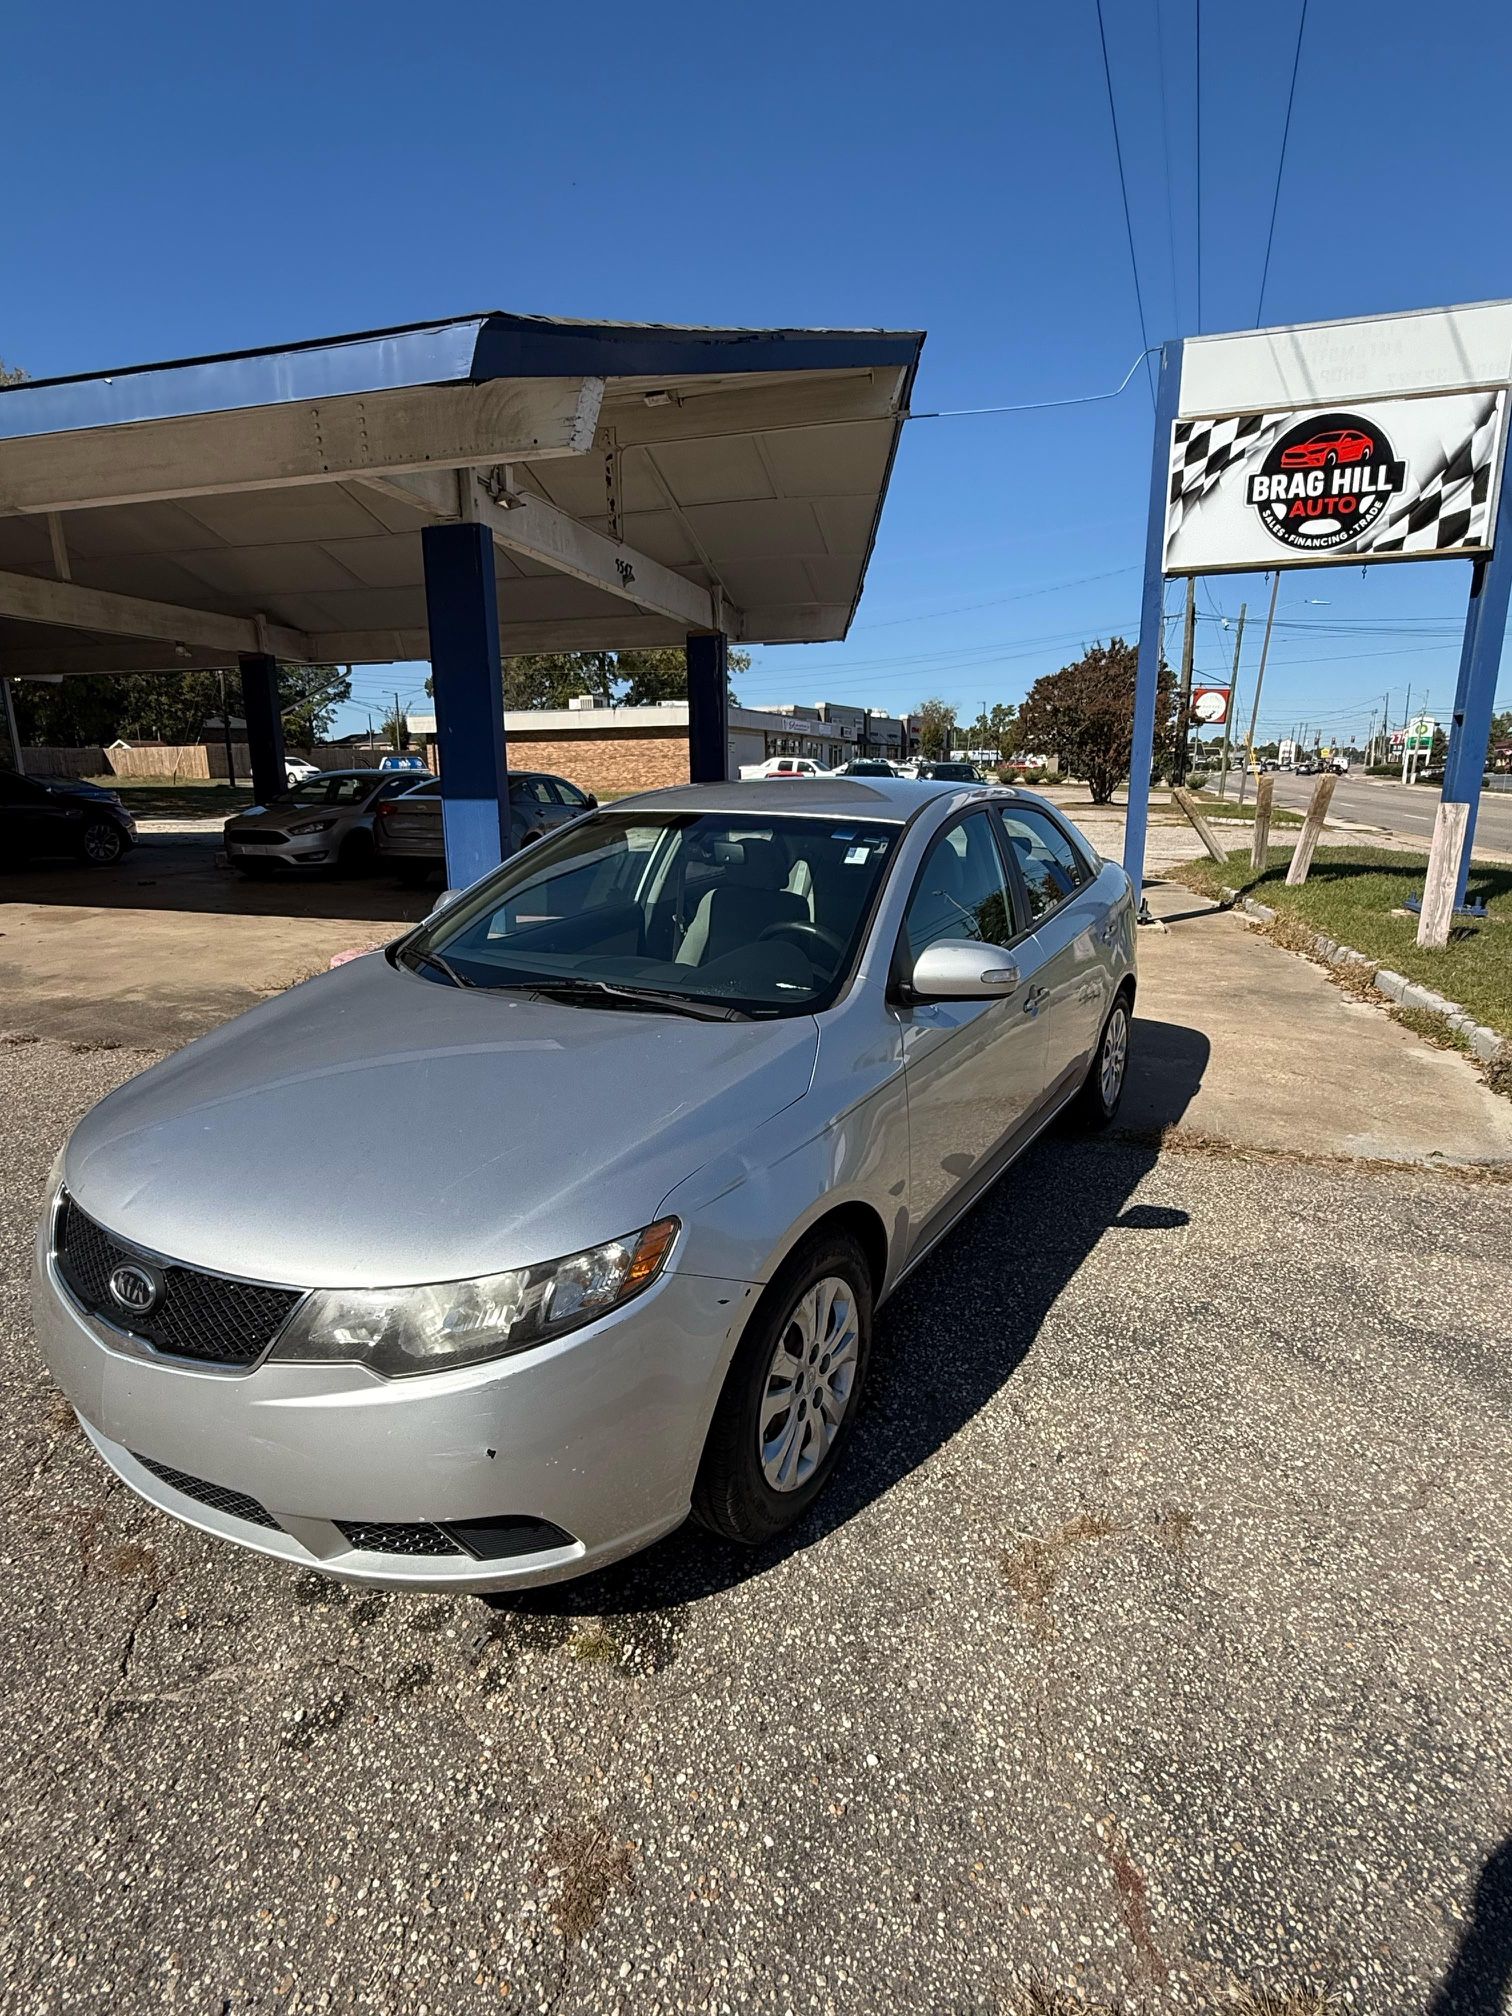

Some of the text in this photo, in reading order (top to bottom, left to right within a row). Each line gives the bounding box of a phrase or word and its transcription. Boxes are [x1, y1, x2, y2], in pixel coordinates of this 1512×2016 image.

[1253, 465, 1393, 501] BRAG HILL
[1262, 500, 1383, 547] SALES FINANCING TRADE
[1289, 496, 1357, 518] AUTO
[117, 1271, 144, 1304] KIA
